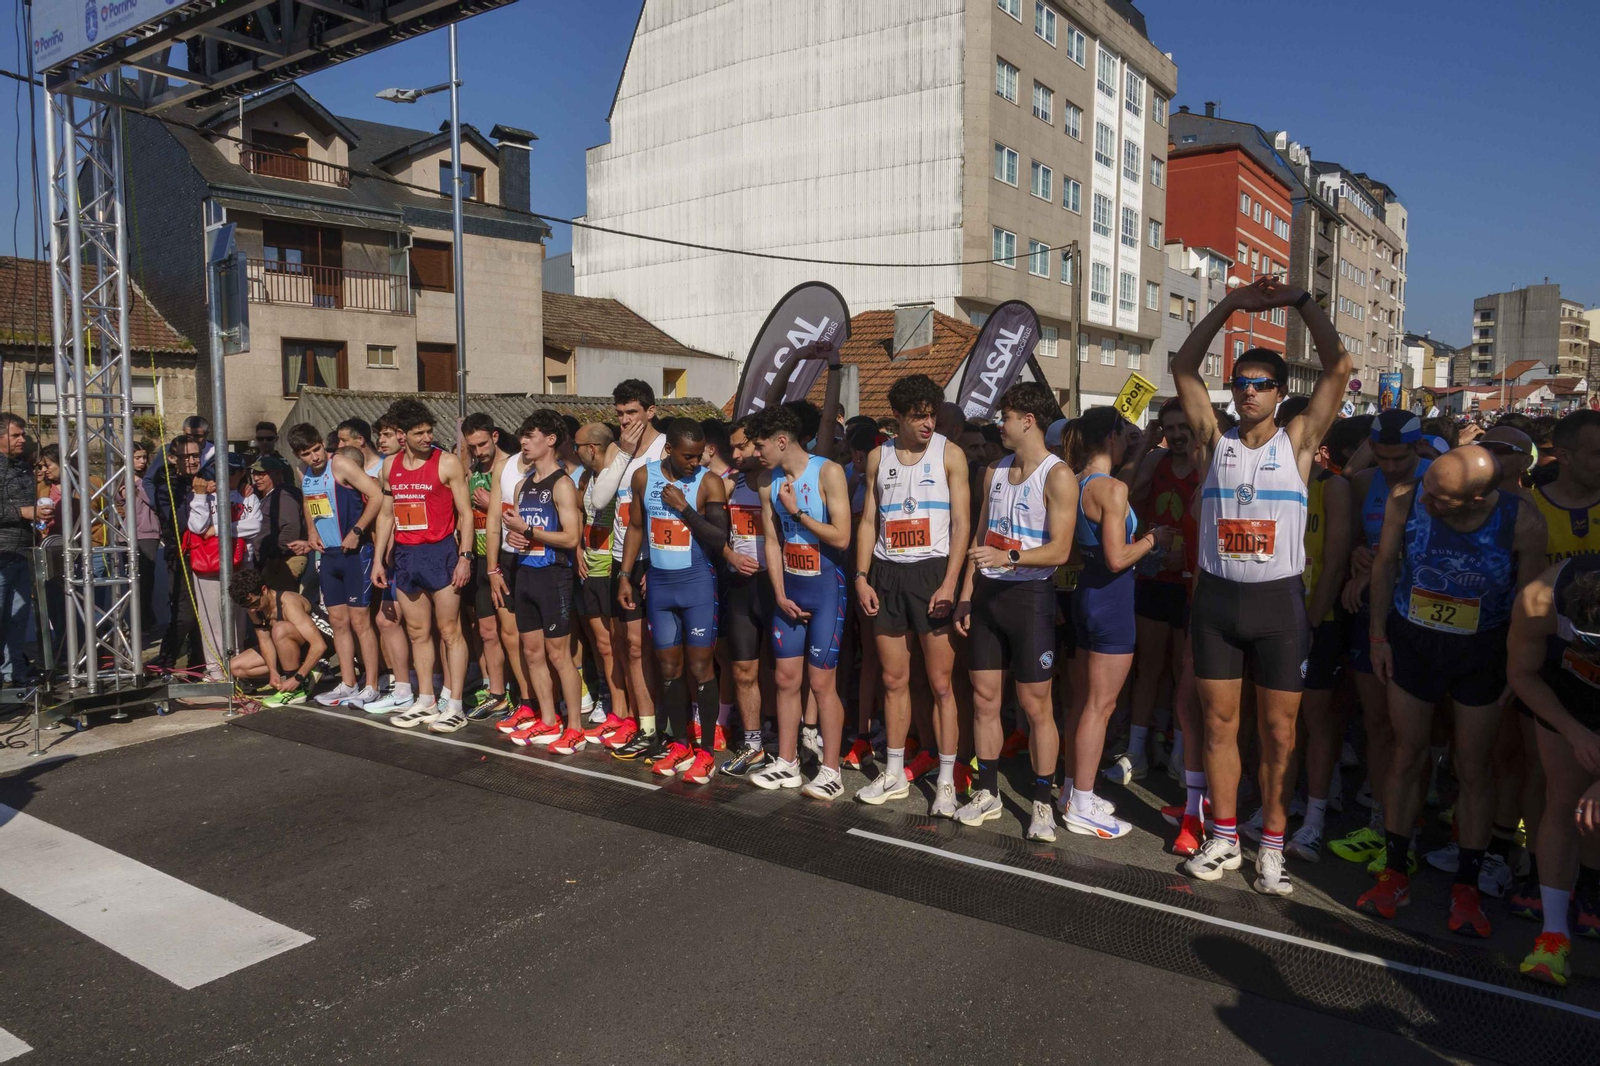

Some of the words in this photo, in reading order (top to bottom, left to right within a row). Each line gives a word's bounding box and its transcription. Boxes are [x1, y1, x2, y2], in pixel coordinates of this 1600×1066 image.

[1015, 327, 1033, 357] cocinas
[971, 324, 1025, 405] LASAL
[410, 483, 433, 491] TEAM
[309, 503, 321, 515] 101
[407, 512, 411, 525] 1
[747, 520, 754, 534] 9
[664, 530, 672, 544] 3
[891, 530, 925, 549] 2003
[1225, 533, 1267, 553] 2006
[786, 552, 814, 570] 2005
[1431, 549, 1482, 567] RUNNERS
[1430, 603, 1457, 626] 32
